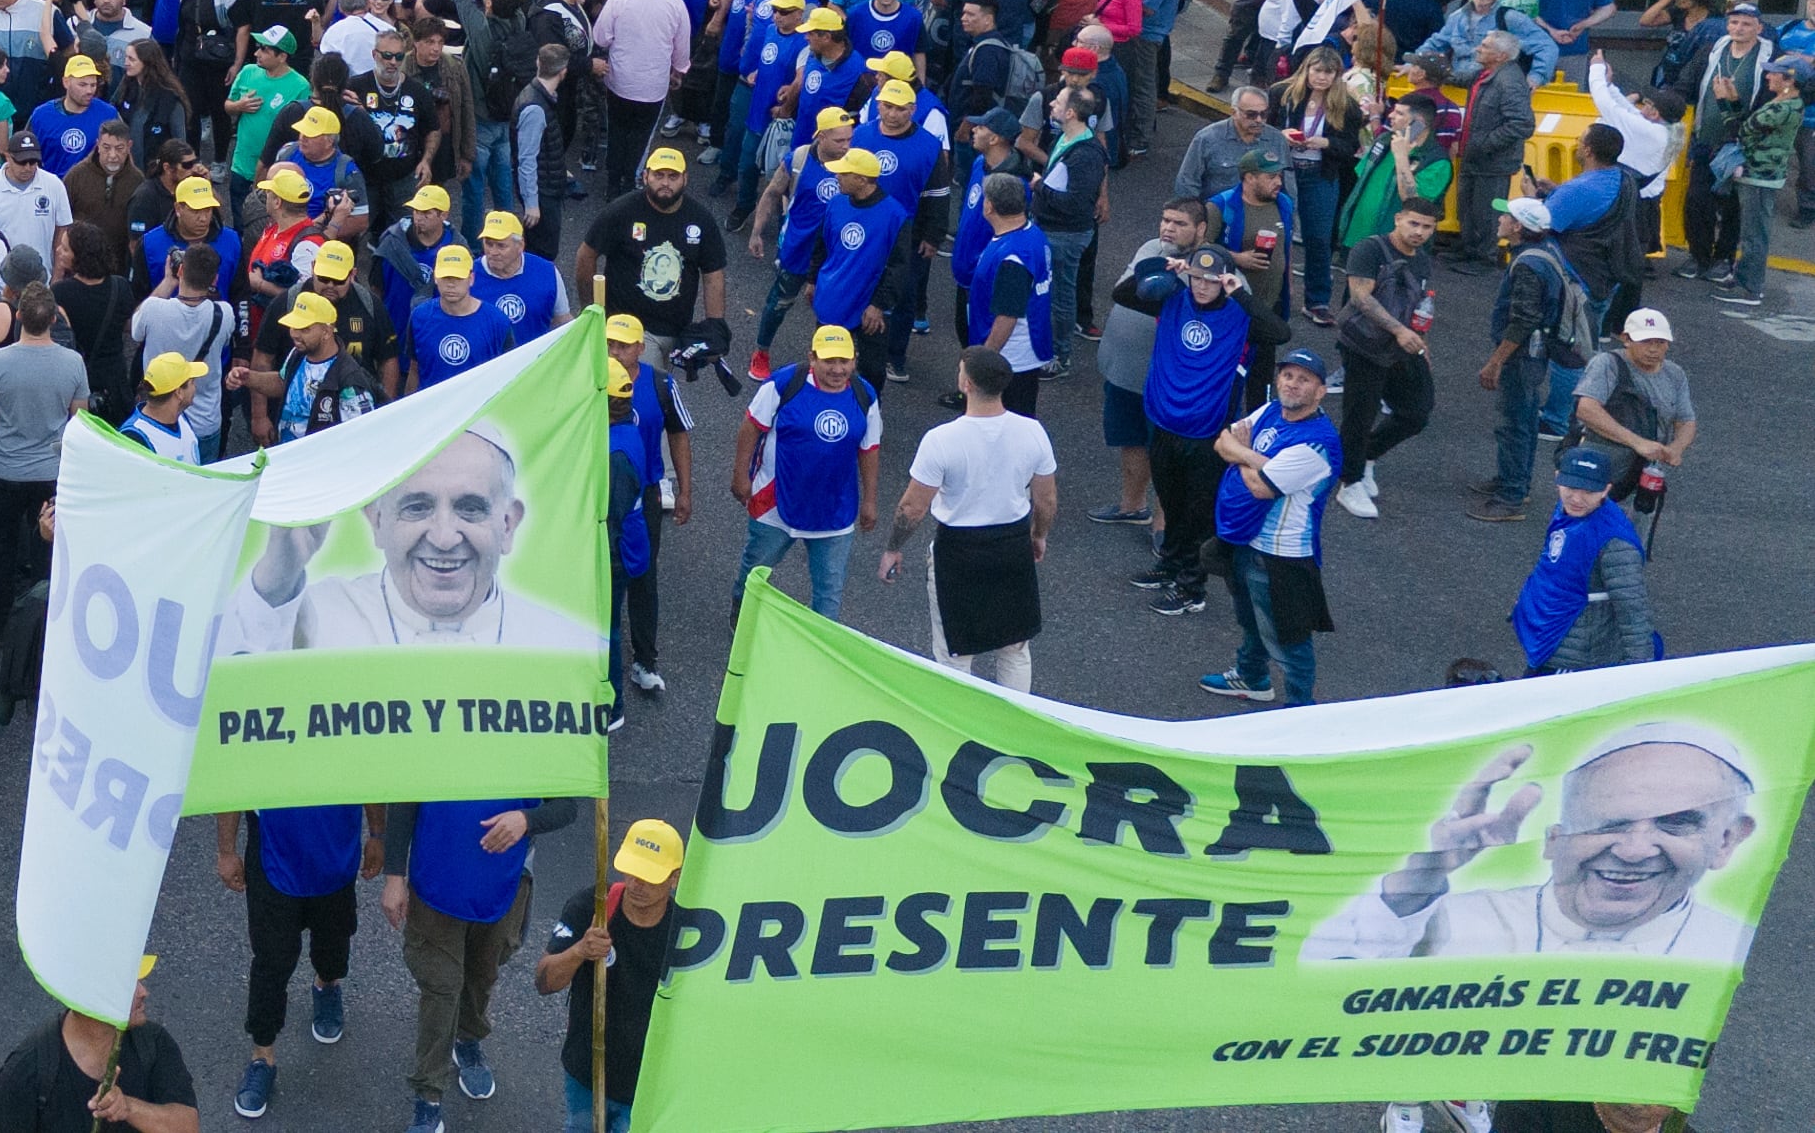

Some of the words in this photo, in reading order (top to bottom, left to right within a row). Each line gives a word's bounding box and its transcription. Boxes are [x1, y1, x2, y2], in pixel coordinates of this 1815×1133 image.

[219, 707, 296, 744] PAZ,
[306, 698, 412, 739] AMOR
[422, 698, 446, 733] Y
[457, 697, 611, 735] TRABAJO
[694, 719, 1334, 858] UOCRA
[634, 836, 661, 854] UOCRA
[664, 891, 1290, 983] PRESENTE
[1342, 975, 1530, 1015] GANARÁS
[1536, 978, 1583, 1006] EL
[1594, 979, 1690, 1010] PAN
[1212, 1038, 1293, 1062] CON
[1297, 1036, 1342, 1060] EL
[1352, 1030, 1502, 1058] SUDOR
[1498, 1028, 1554, 1056] DE
[1565, 1029, 1616, 1058] TU
